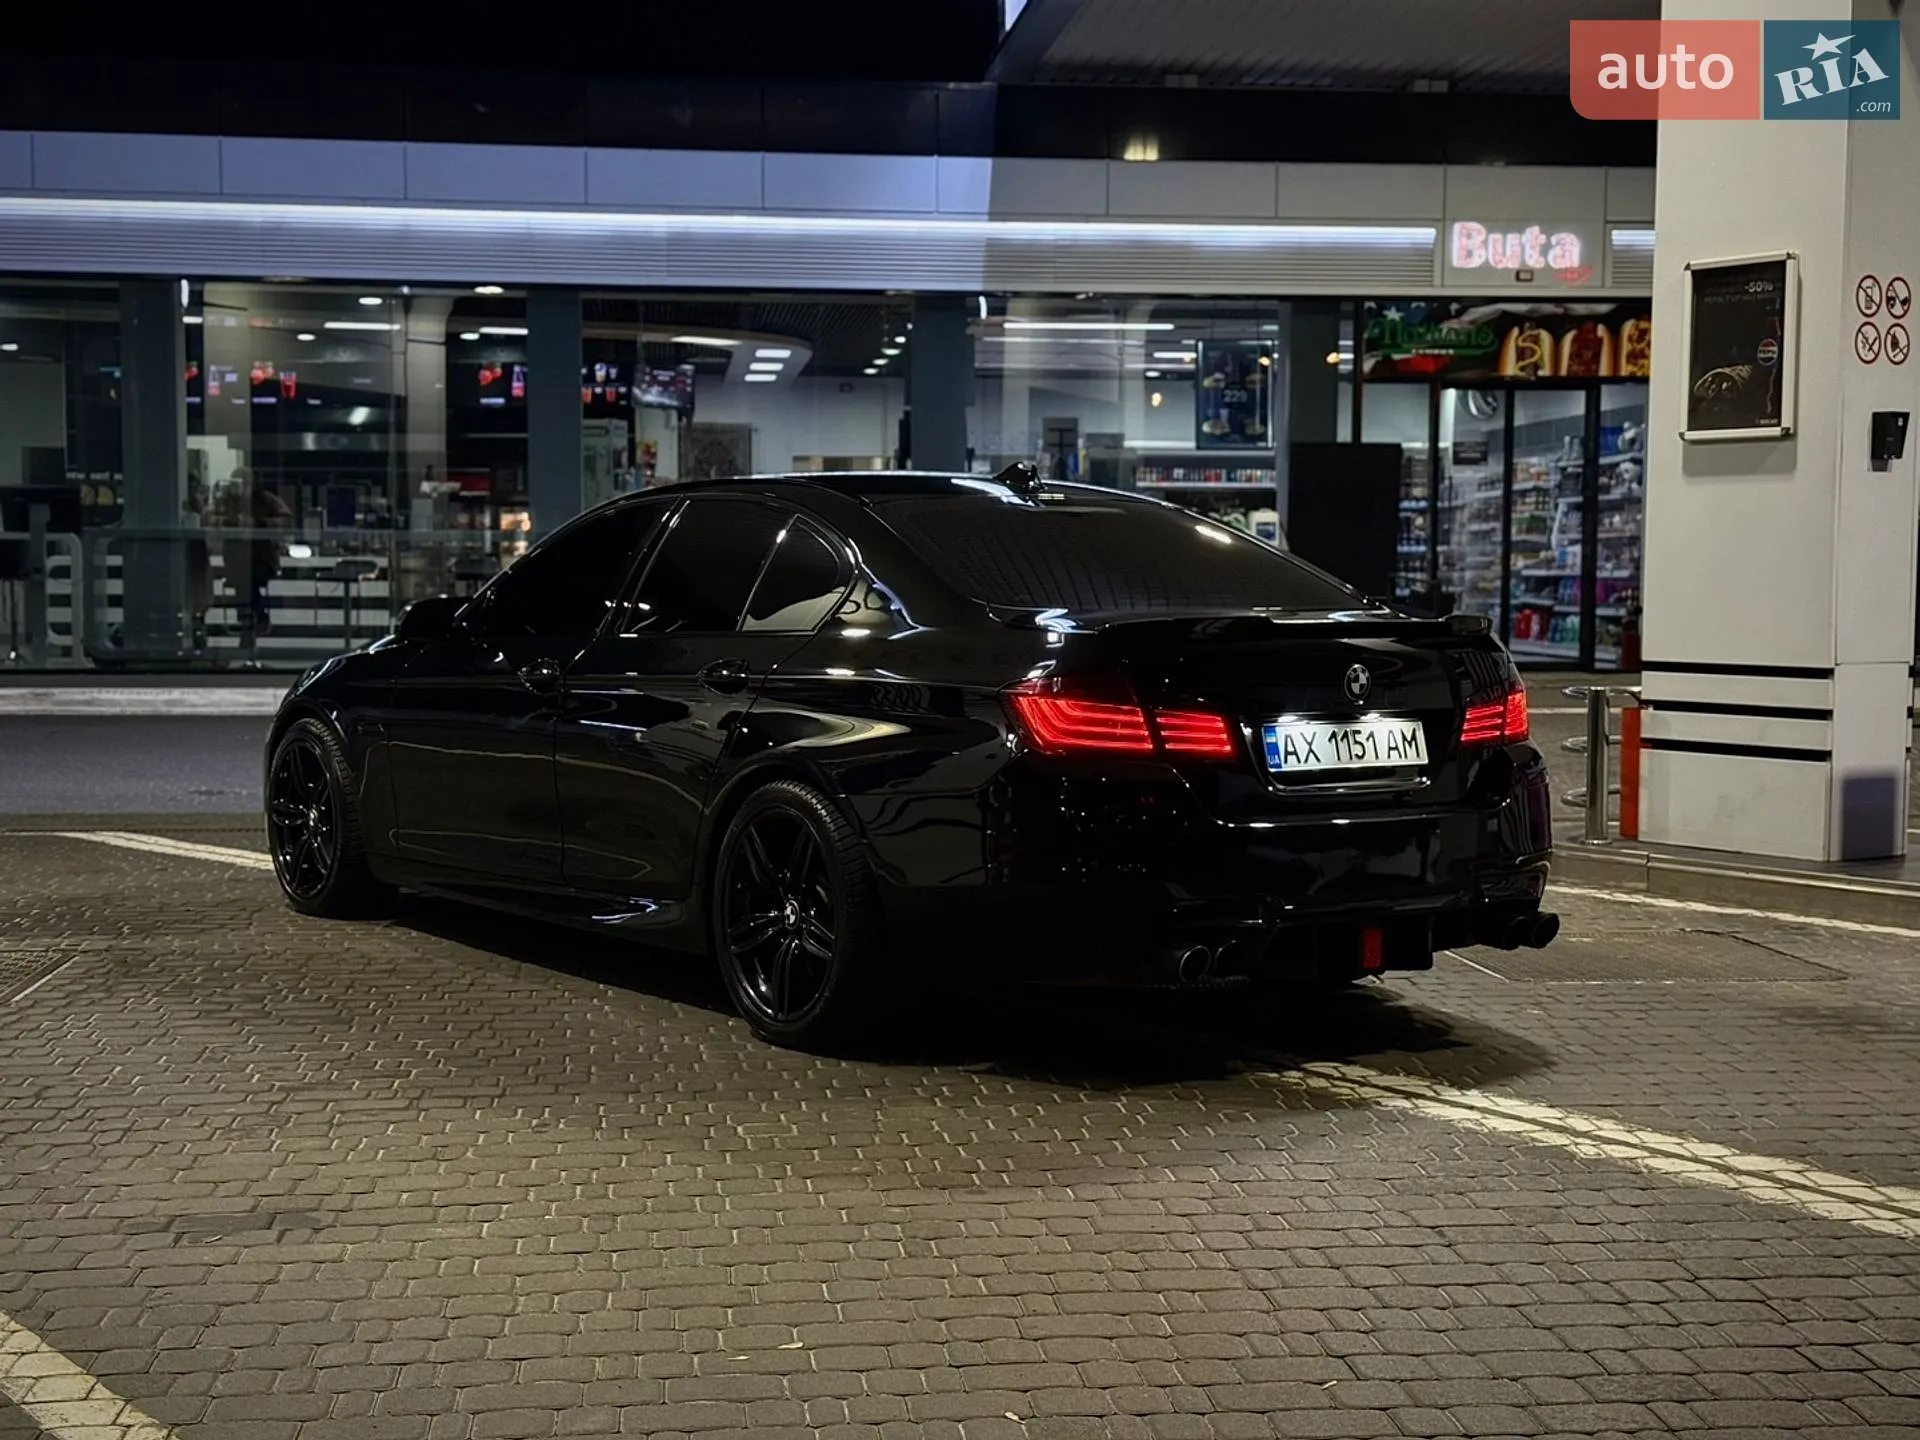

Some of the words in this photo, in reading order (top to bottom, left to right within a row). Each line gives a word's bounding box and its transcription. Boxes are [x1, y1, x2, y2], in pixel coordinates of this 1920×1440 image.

[1452, 220, 1581, 269] Buta
[1268, 755, 1281, 766] UA
[1283, 731, 1321, 764] AX
[1327, 728, 1380, 761] 1151
[1387, 727, 1421, 760] AM
